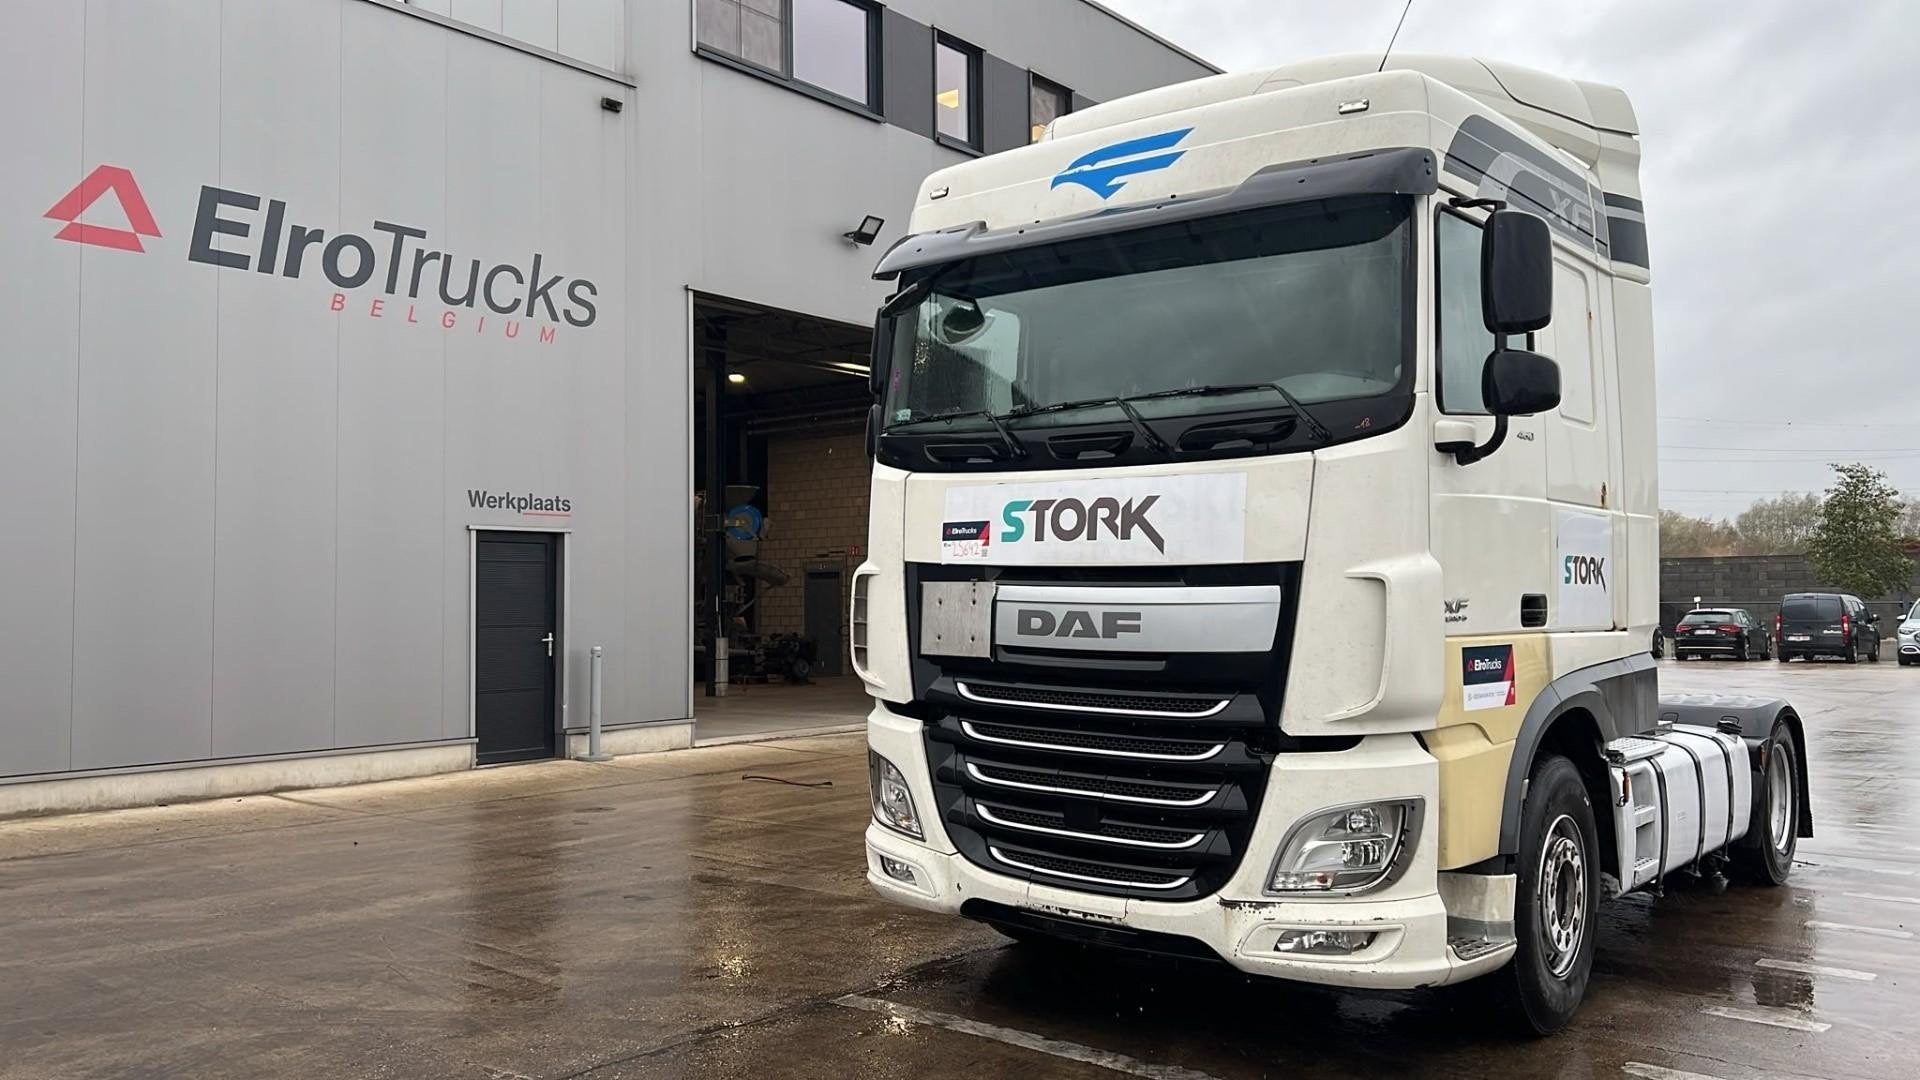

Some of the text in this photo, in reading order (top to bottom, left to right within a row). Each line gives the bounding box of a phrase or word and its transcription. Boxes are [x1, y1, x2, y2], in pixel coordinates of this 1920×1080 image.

[188, 185, 598, 328] ElroTrucks
[331, 293, 556, 343] BELGIUM
[468, 489, 571, 513] Werkplaats
[1001, 495, 1164, 554] STORK
[1564, 555, 1606, 592] STORK
[1018, 609, 1142, 639] DAF
[1474, 658, 1502, 671] ElroTrucks
